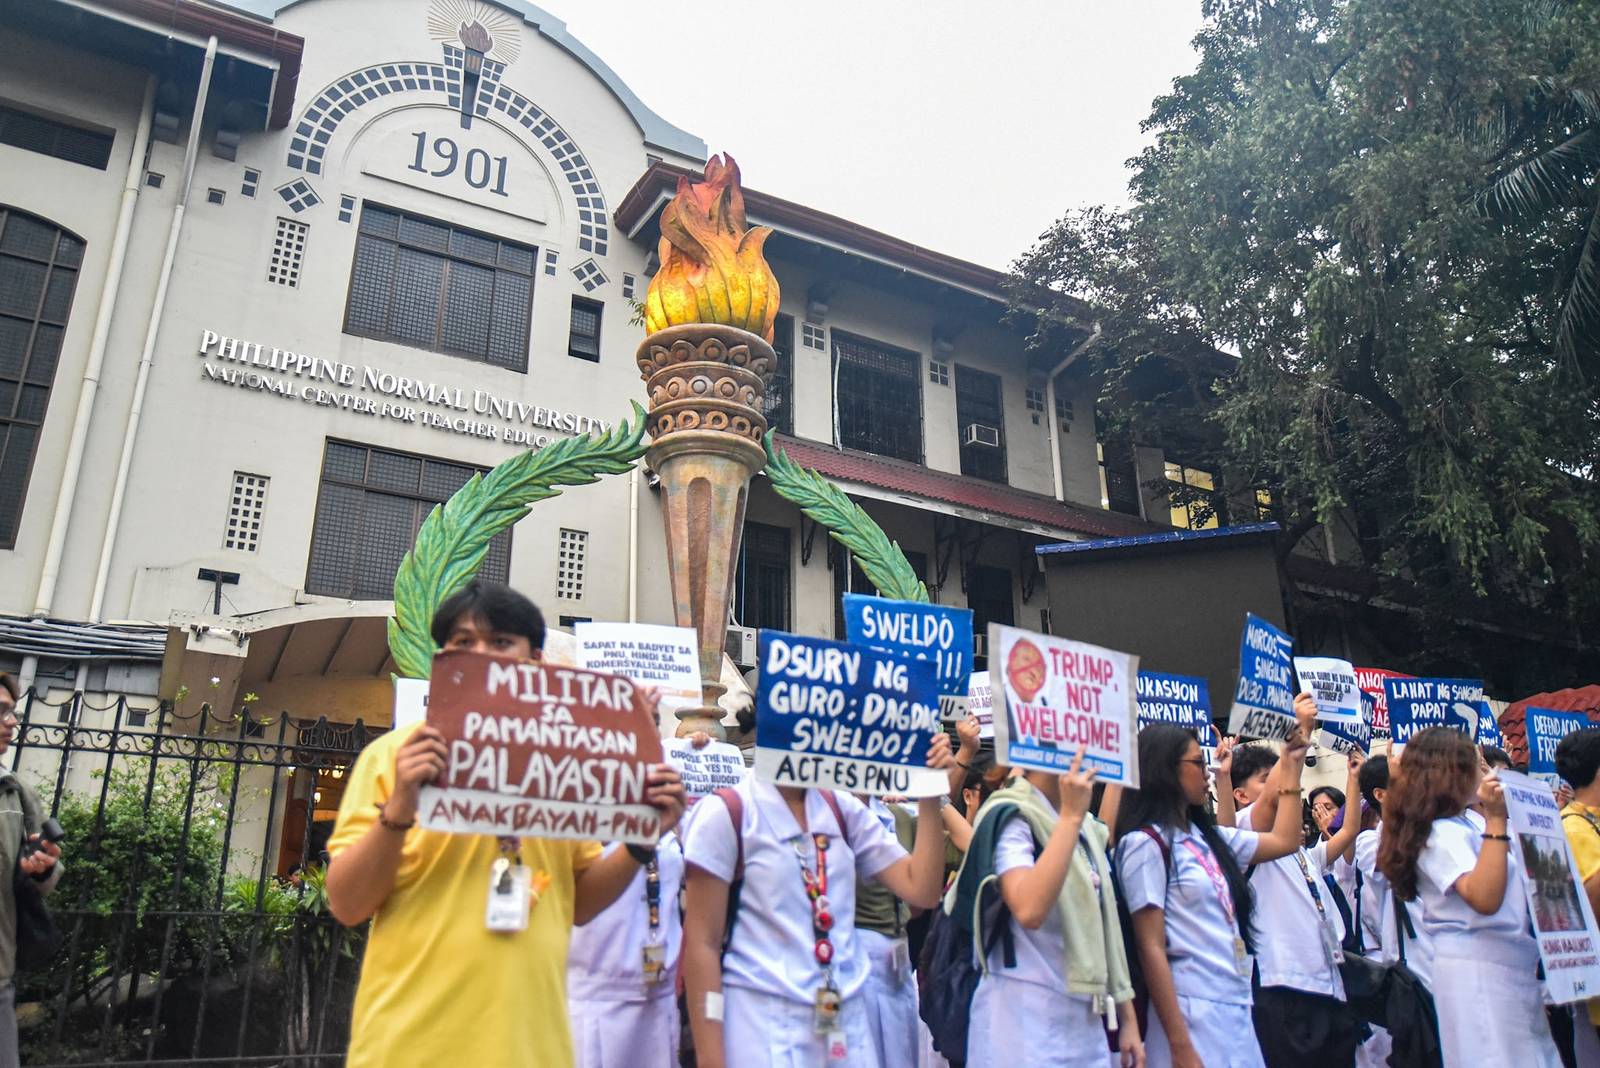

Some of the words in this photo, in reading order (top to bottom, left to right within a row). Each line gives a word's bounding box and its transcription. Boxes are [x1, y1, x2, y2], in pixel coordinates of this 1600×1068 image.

[407, 131, 509, 197] 1901
[199, 328, 356, 387] PHILIPPINE
[360, 365, 469, 412] NORMAL
[202, 361, 298, 399] NATIONAL
[301, 385, 376, 415] CENTER
[380, 401, 416, 423] FOR
[420, 408, 498, 440] TEACHER
[584, 640, 616, 650] SAPAT
[620, 640, 635, 649] NA
[638, 642, 675, 653] BADYET
[678, 646, 691, 655] SA
[631, 651, 659, 660] HINDI
[661, 653, 674, 662] SA
[766, 638, 861, 686] DSURV
[872, 660, 910, 694] NG
[1048, 646, 1119, 693] TRUMP,
[487, 661, 634, 712] MILITAR
[1066, 681, 1103, 715] NOT
[1136, 676, 1198, 703] UKASYON
[1392, 682, 1433, 699] LAHAT
[1437, 683, 1450, 700] NG
[540, 703, 574, 724] SA
[1136, 702, 1194, 723] ARAPATAN
[1410, 703, 1447, 719] DAPAT
[1533, 714, 1560, 735] DEFEND
[463, 711, 638, 756] PAMANTASAN
[790, 717, 918, 764] SWELDO!
[1016, 703, 1120, 754] WELCOME!
[449, 738, 645, 805] PALAYASIN
[703, 754, 721, 763] THE
[704, 764, 720, 773] YES
[723, 764, 733, 774] TO
[864, 764, 911, 791] PNU
